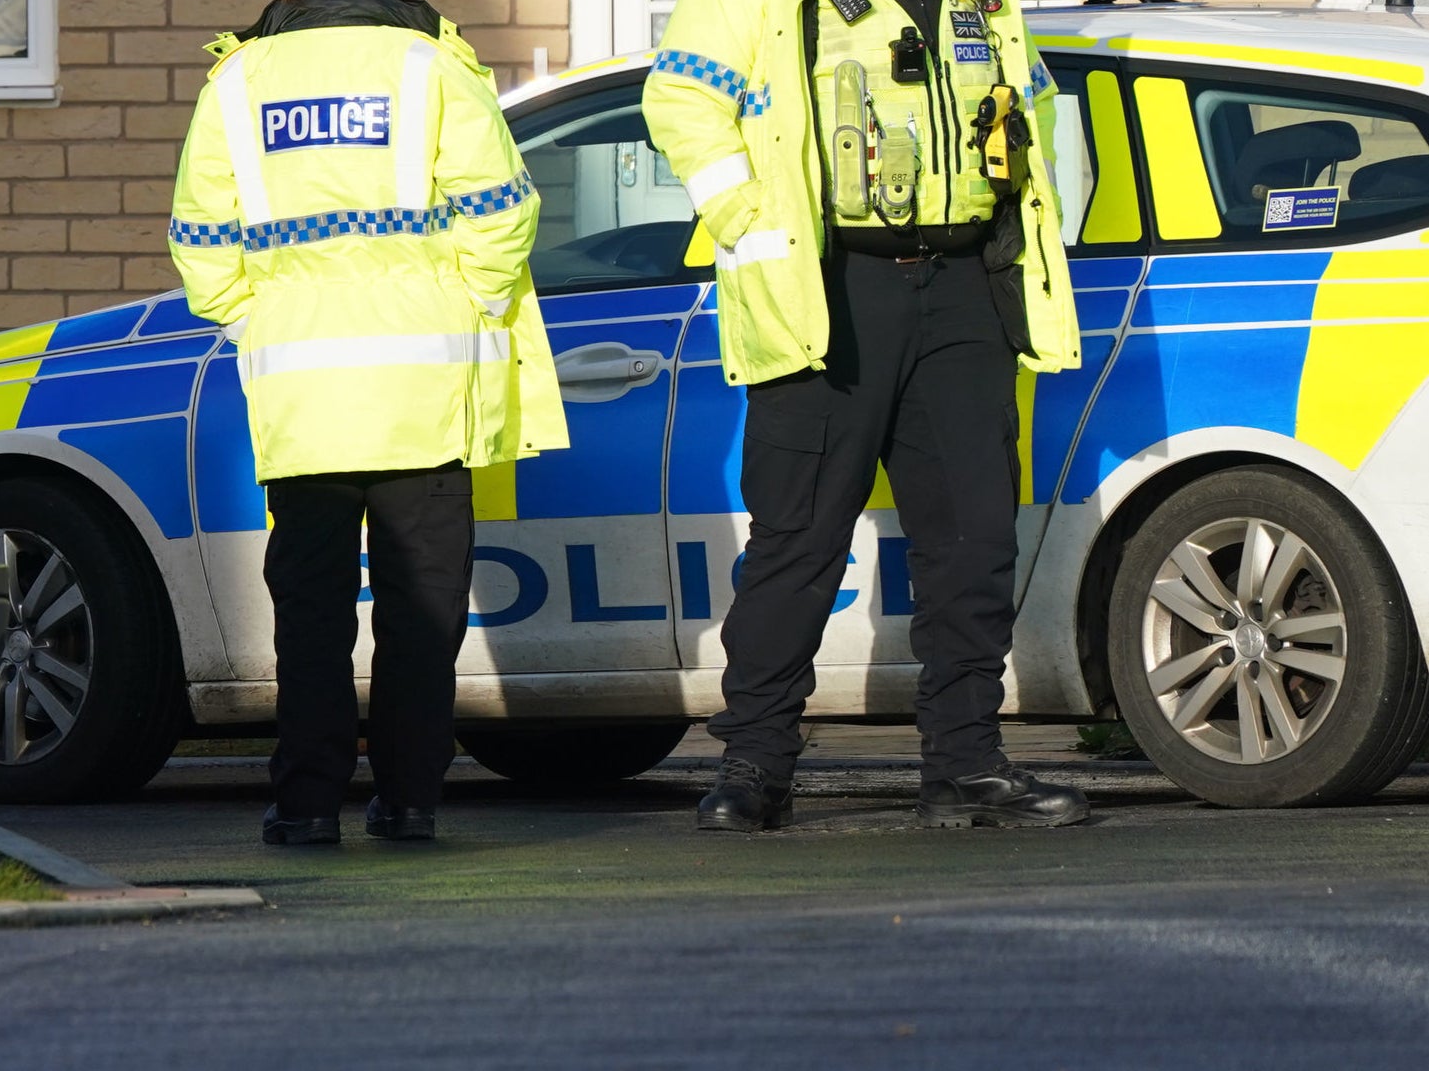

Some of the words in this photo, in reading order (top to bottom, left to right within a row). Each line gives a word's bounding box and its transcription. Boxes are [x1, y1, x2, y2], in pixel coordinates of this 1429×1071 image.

[956, 46, 989, 60] POLICE
[266, 102, 385, 145] POLICE
[891, 173, 908, 182] 687
